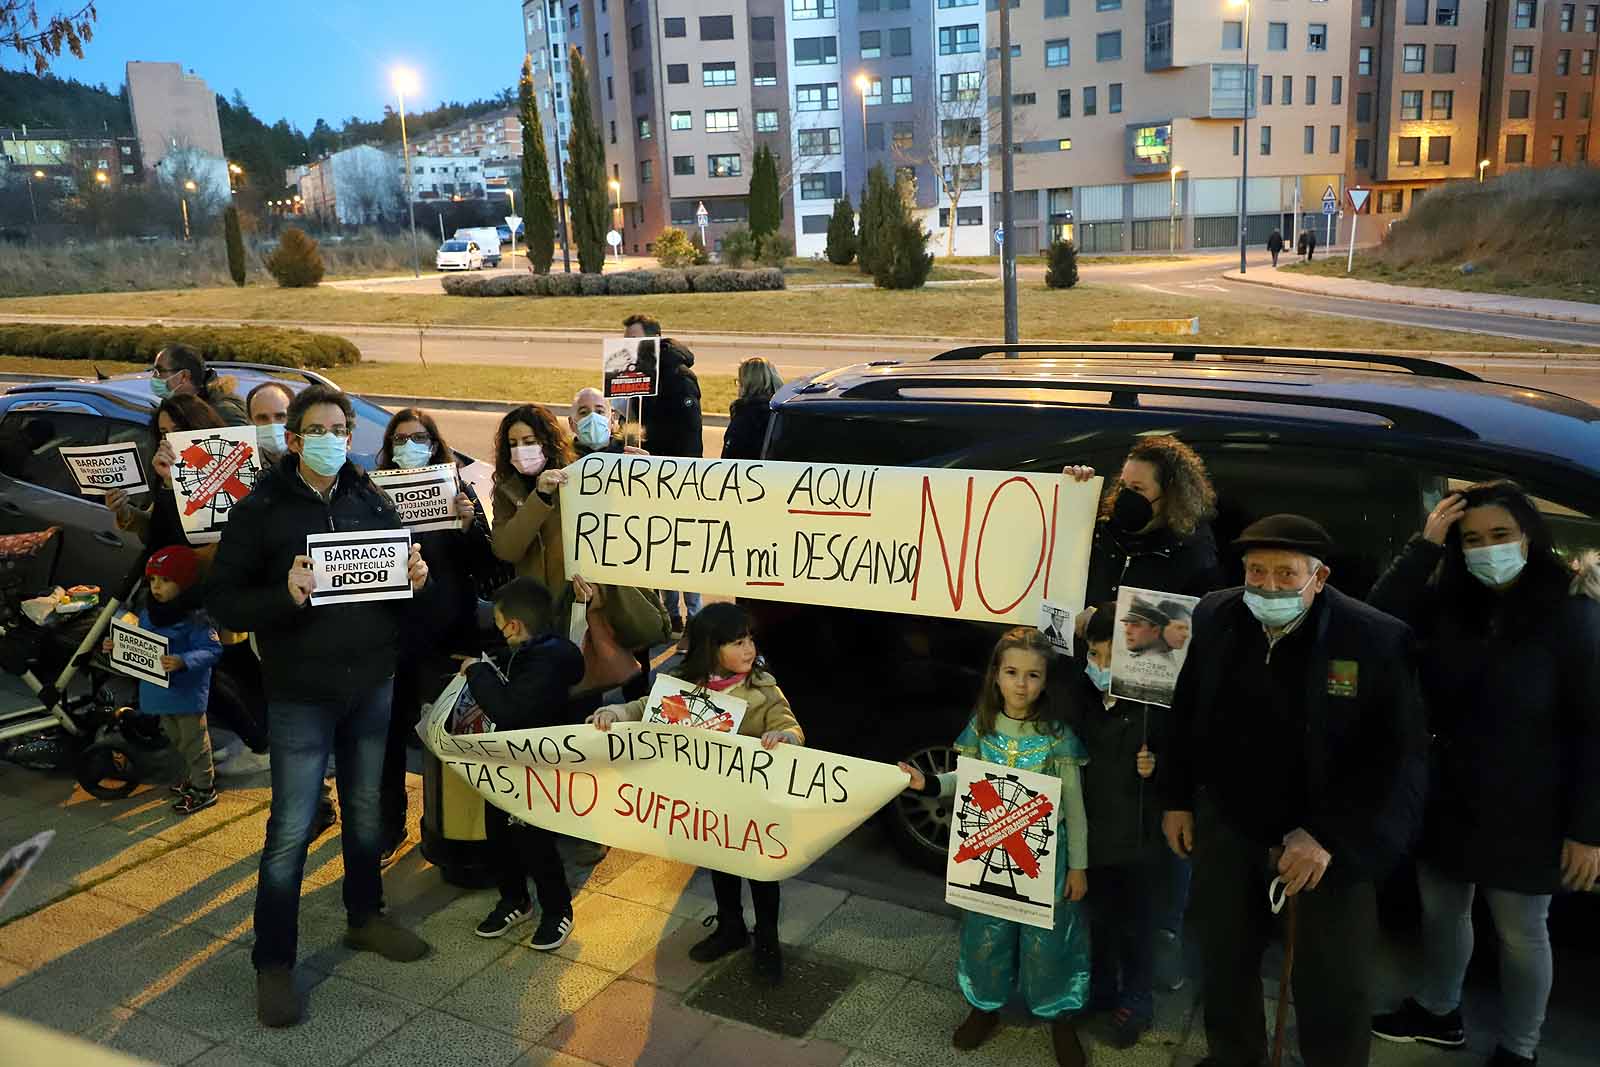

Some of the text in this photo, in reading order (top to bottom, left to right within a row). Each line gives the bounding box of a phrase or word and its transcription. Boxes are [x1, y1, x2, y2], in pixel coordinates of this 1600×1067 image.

[75, 455, 126, 468] BARRACAS
[87, 465, 127, 475] FUENTECILLAS
[199, 444, 246, 492] FUENTECILLAS
[579, 457, 880, 510] BARRACAS AQUÍ
[395, 486, 441, 503] ¡NO!
[400, 499, 437, 510] FUENTECILL
[400, 506, 448, 520] BARRACA
[324, 546, 396, 562] BARRACAS
[575, 512, 921, 585] RESPETA mi DESCANSO
[325, 560, 395, 572] EN FUENTECILLAS
[332, 570, 388, 588] ¡NO!
[119, 633, 159, 654] BARRACAS
[126, 644, 158, 660] FUENTECILLAS
[123, 651, 154, 669] ¡NO!
[438, 728, 849, 804] EREMOS DISFRUTAR LAS
[526, 765, 598, 817] NO
[614, 783, 788, 859] SUFRIRLAS
[985, 805, 1007, 824] NO
[963, 837, 977, 849] EN
[977, 797, 1044, 840] FUENTECILLAS
